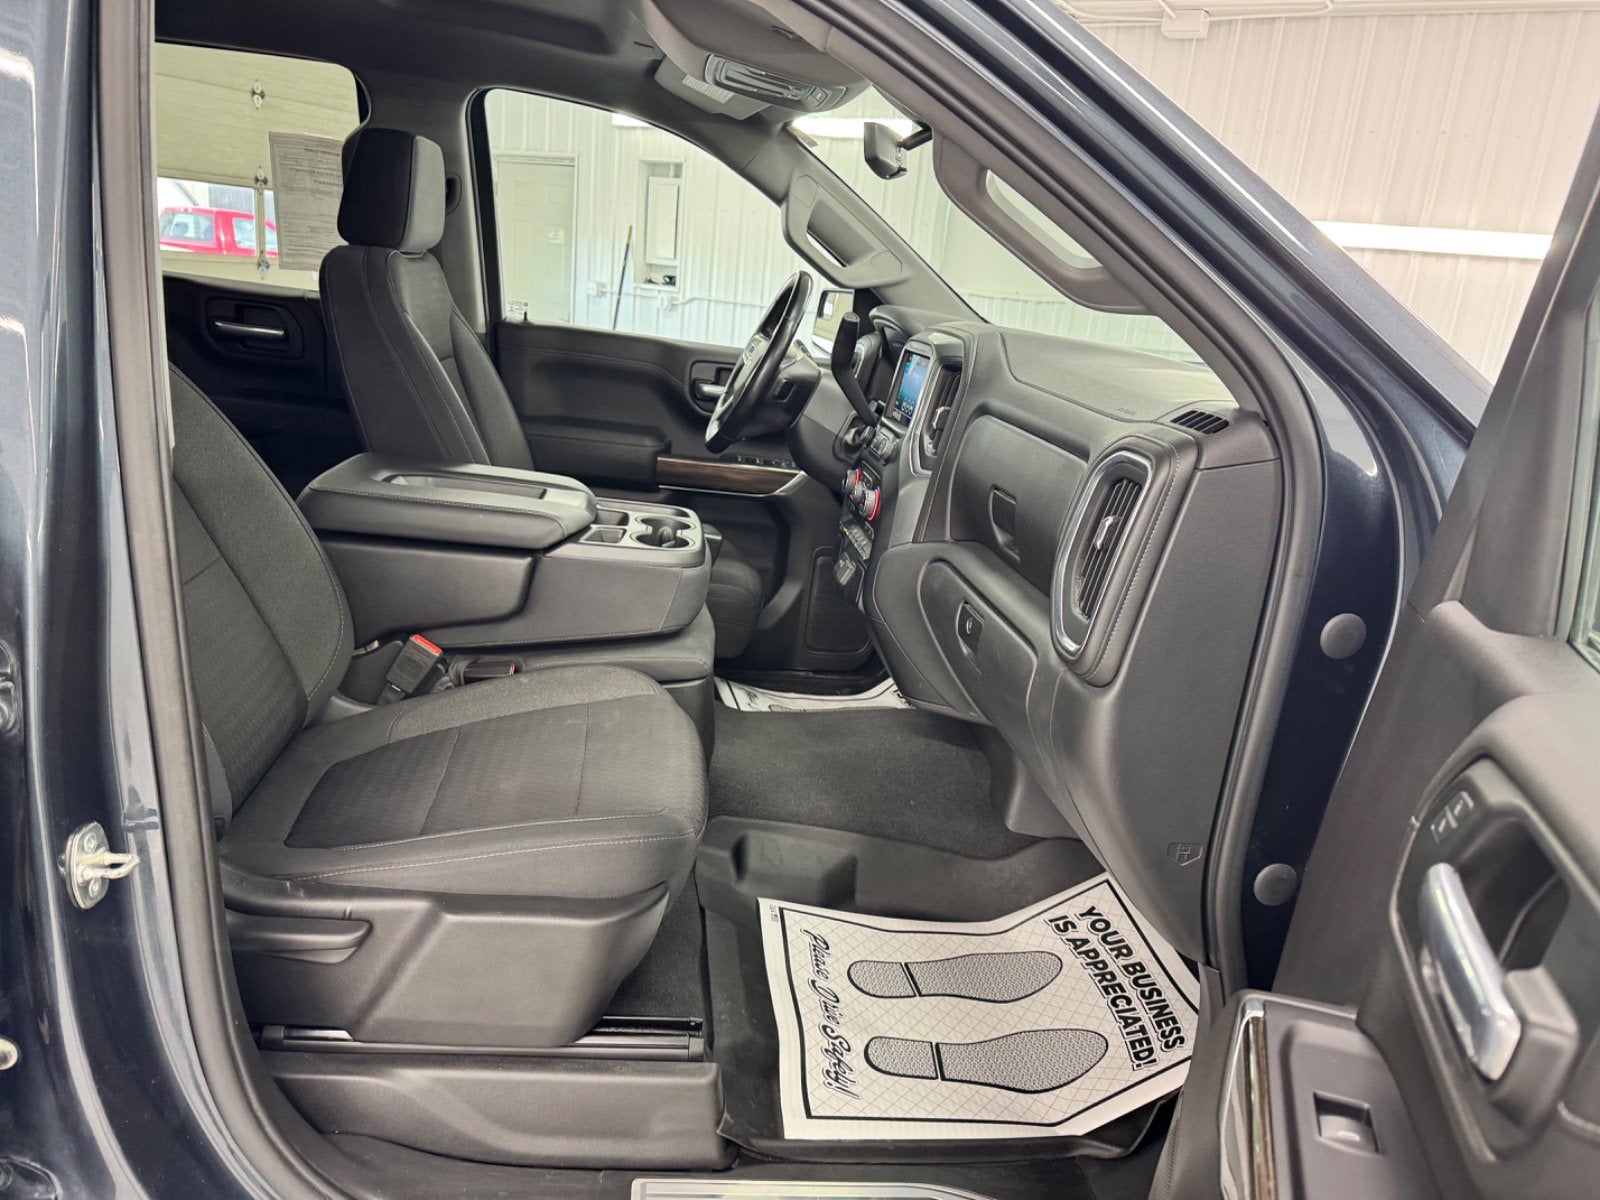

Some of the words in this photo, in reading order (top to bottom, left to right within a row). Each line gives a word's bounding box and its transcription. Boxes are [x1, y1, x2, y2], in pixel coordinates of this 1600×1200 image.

[801, 928, 831, 980] Please
[1047, 914, 1078, 934] IS
[1063, 937, 1158, 1070] APPRECIATED!
[1077, 905, 1134, 961] YOUR
[1119, 960, 1186, 1052] BUSINESS
[809, 978, 843, 1026] Drive
[820, 1023, 861, 1099] Safety!
